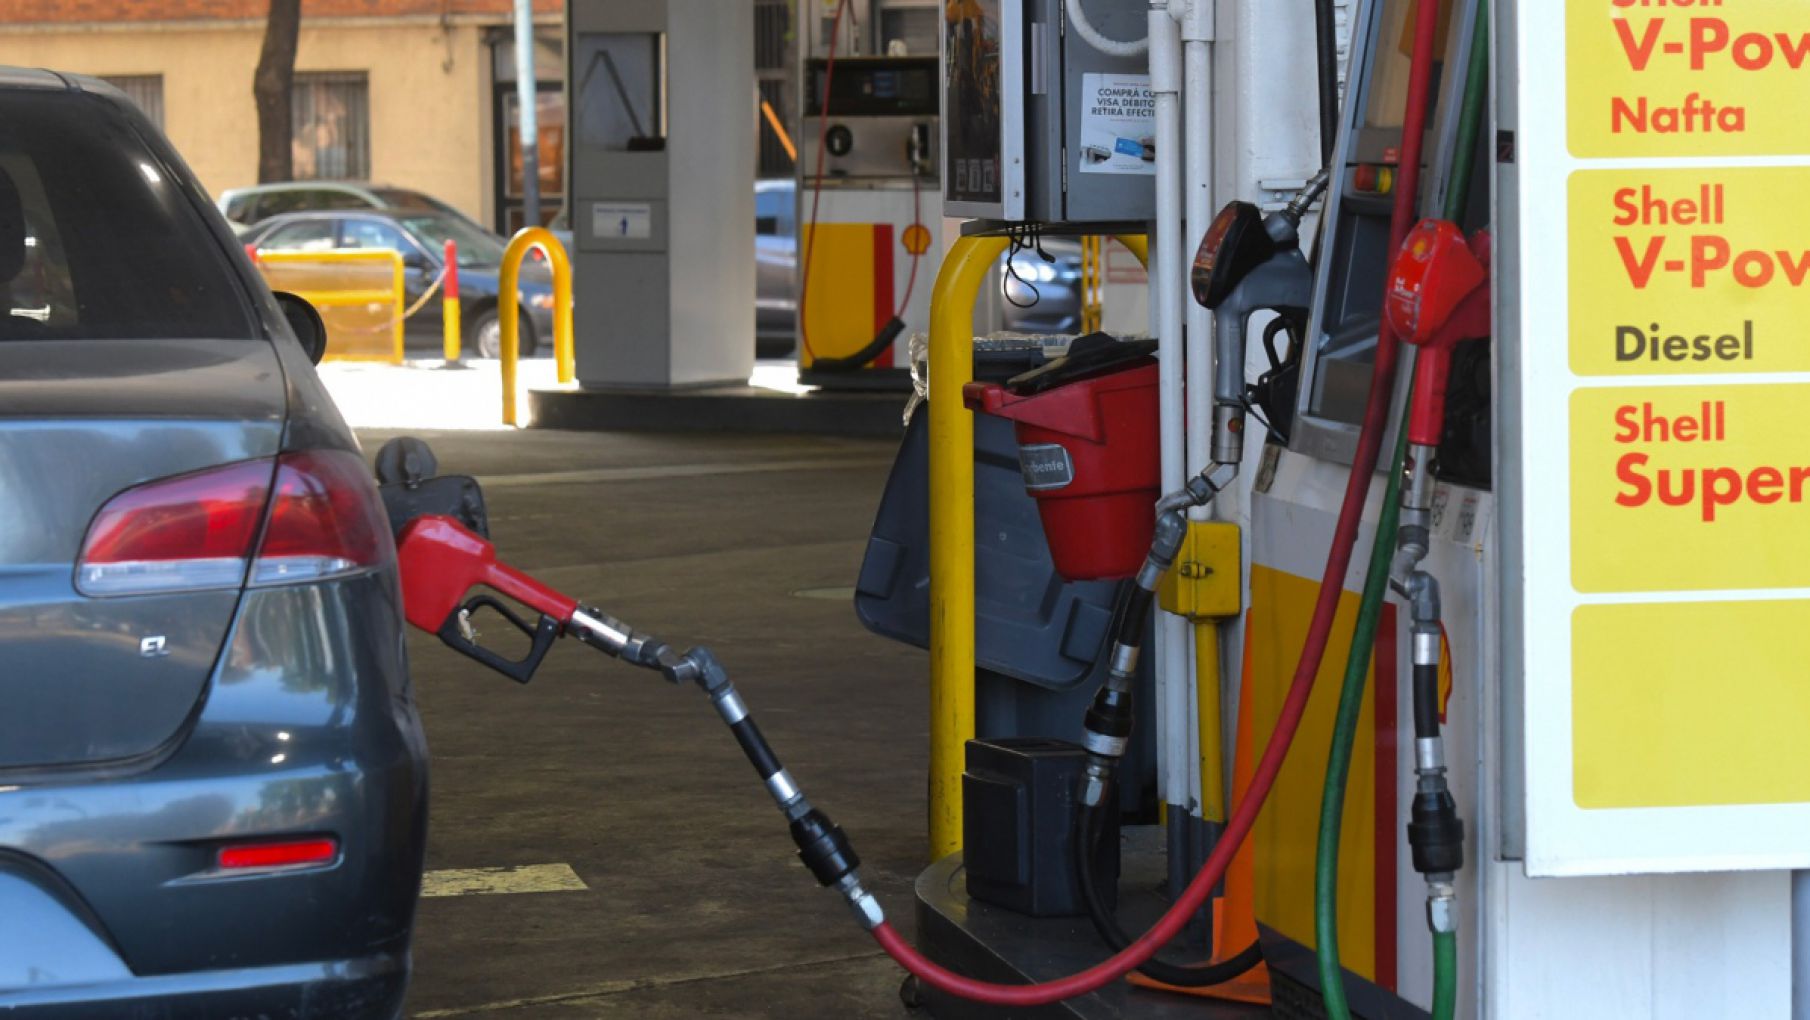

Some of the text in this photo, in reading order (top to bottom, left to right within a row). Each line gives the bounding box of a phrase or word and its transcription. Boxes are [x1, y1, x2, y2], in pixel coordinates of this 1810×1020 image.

[1096, 98, 1120, 107] VISA
[1611, 92, 1745, 133] Nafta
[1613, 184, 1724, 226] Shell
[1615, 320, 1753, 361] Diesel
[1614, 401, 1725, 443] Shell
[1614, 452, 1810, 522] Super
